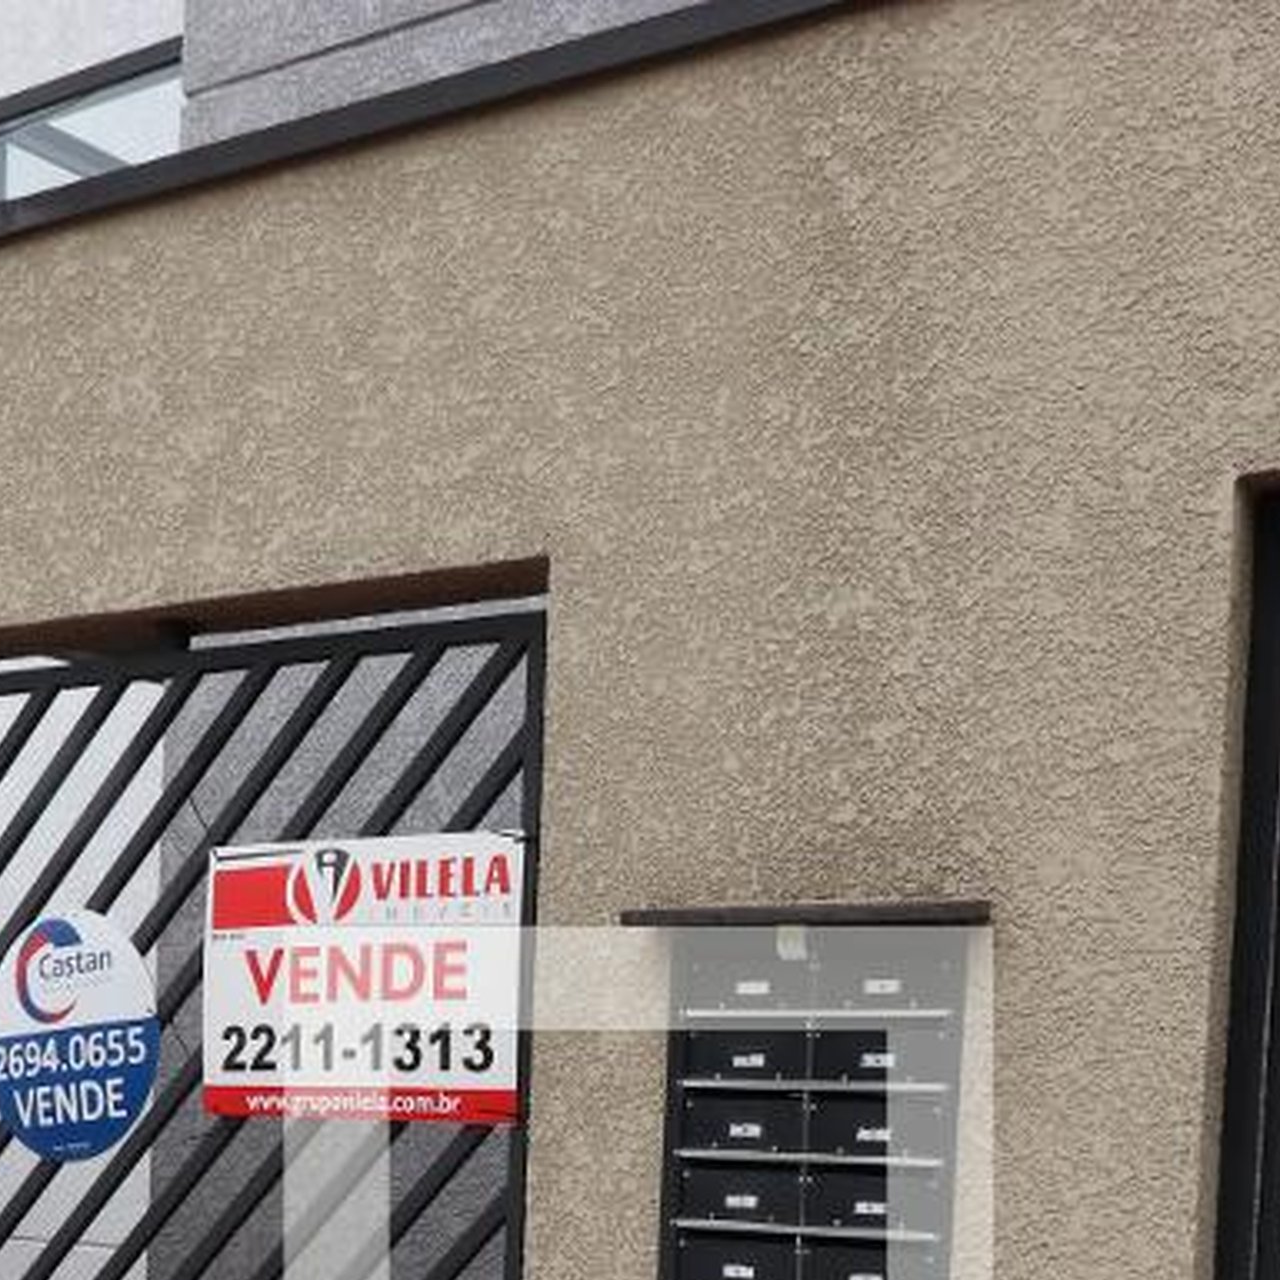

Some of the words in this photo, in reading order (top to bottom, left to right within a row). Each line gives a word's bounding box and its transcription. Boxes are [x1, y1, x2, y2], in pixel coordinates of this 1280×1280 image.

[371, 852, 511, 901] VILELA
[39, 951, 112, 980] Castan
[245, 941, 468, 1006] VENDE
[222, 1022, 495, 1073] 2211-1313
[13, 1078, 129, 1129] VENDE
